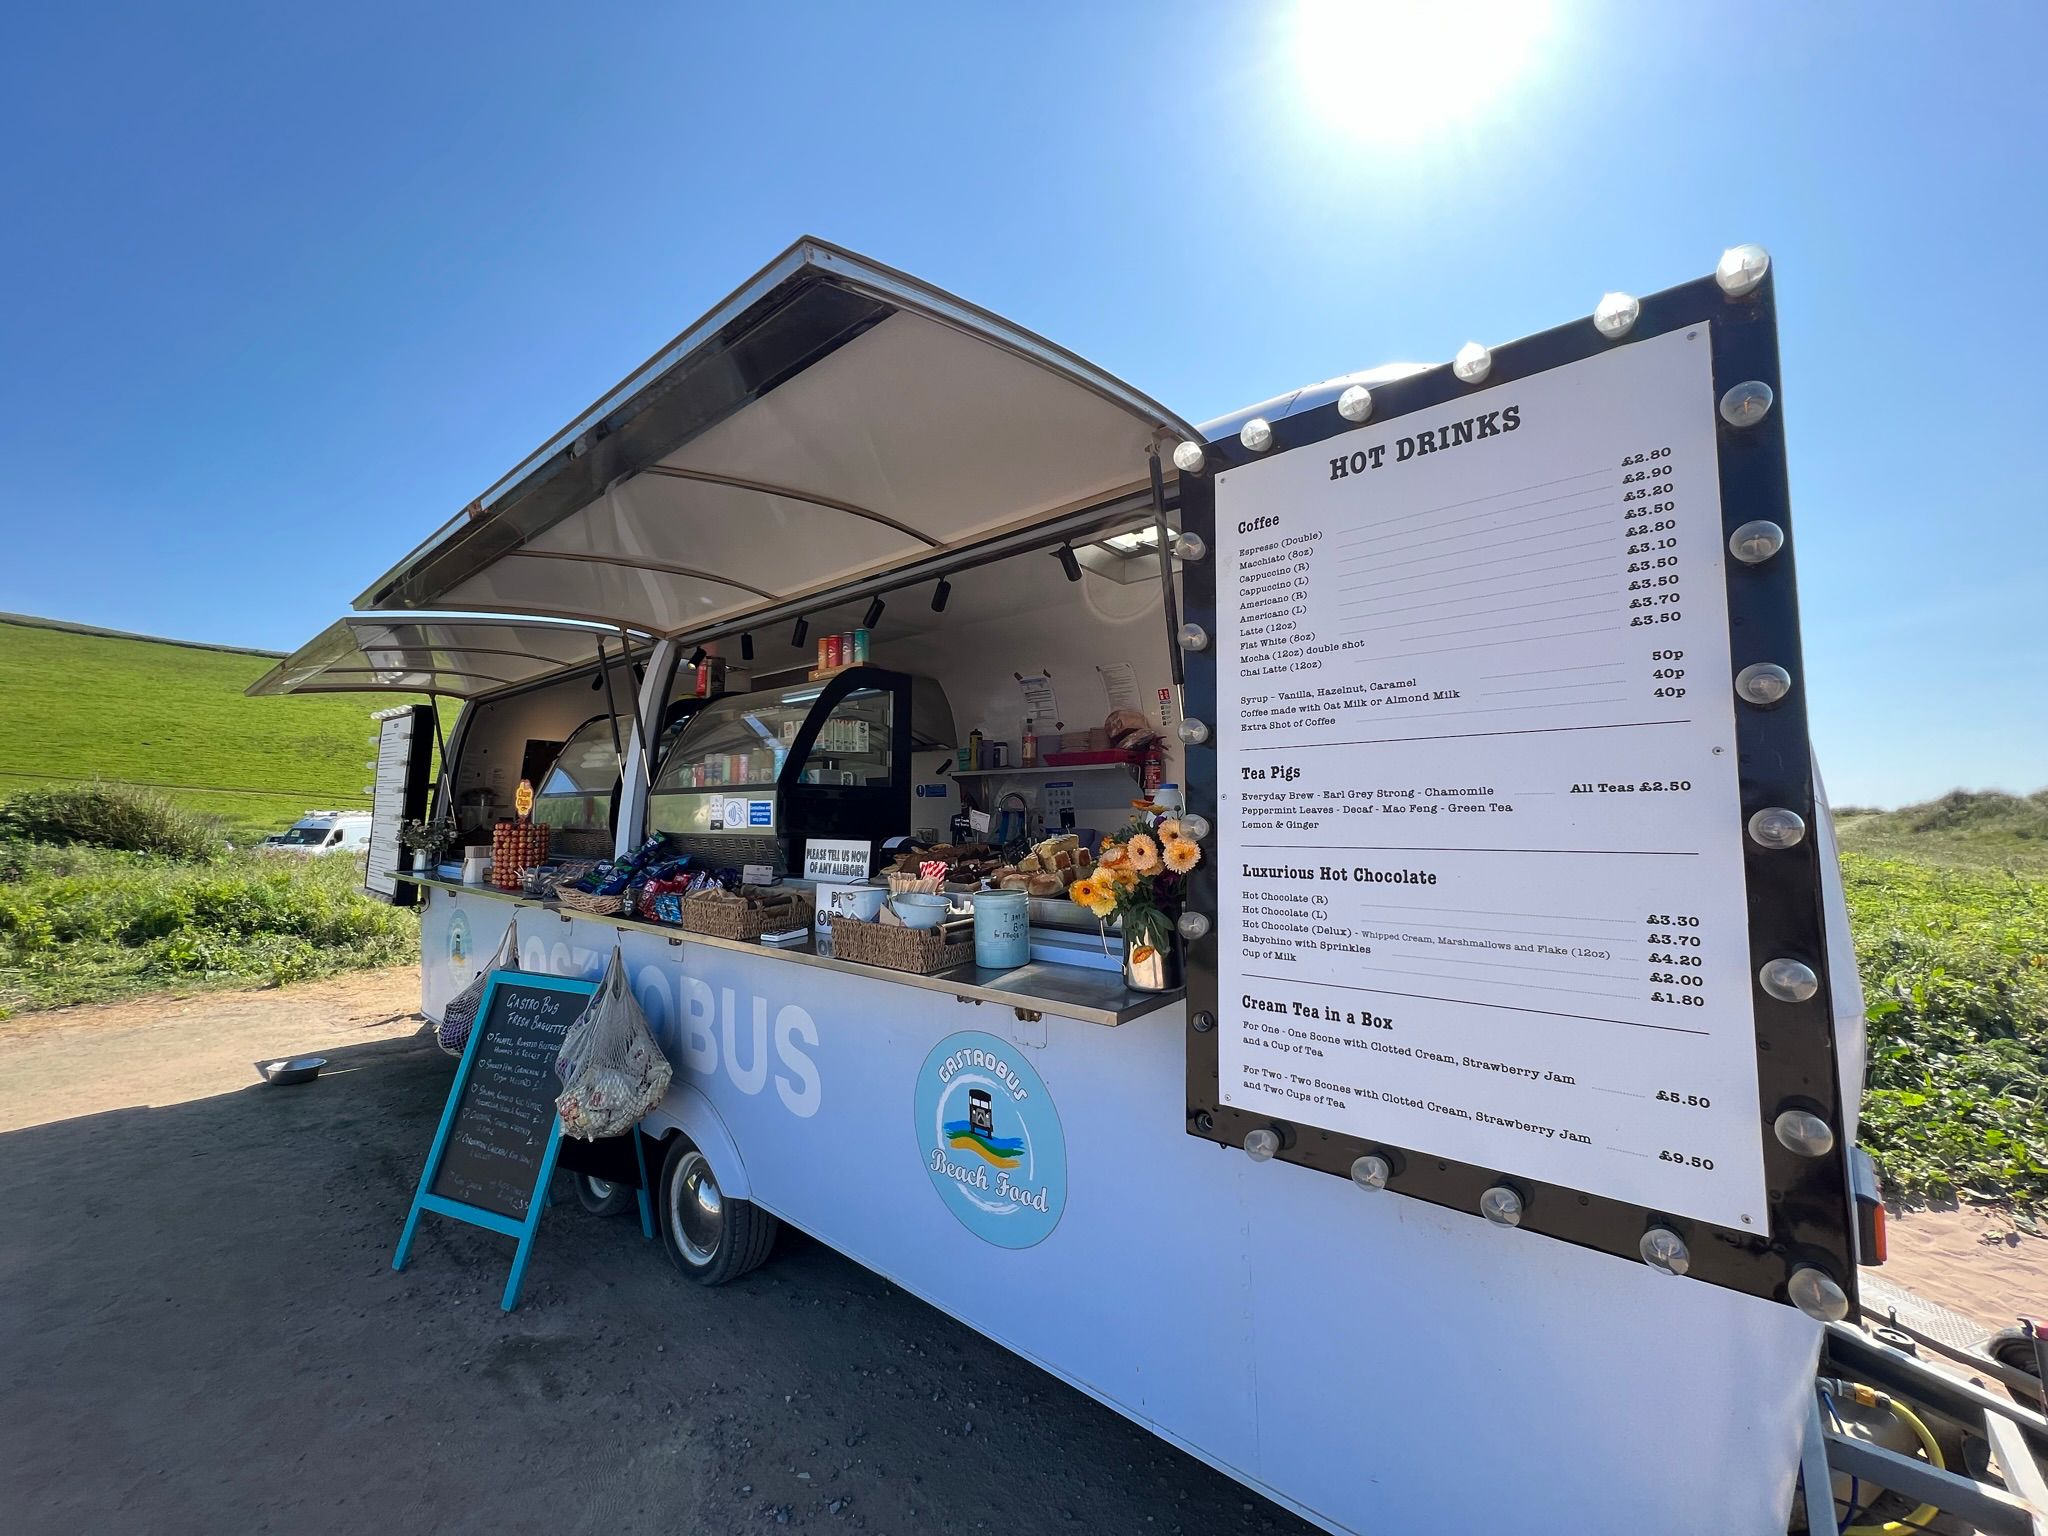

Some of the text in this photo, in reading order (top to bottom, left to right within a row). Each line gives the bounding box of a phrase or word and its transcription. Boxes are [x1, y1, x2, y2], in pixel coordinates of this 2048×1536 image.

[1329, 404, 1521, 481] HOT DRINKS
[1621, 447, 1672, 467] £2.80
[1622, 465, 1673, 485] £2.90
[1623, 483, 1674, 503] £3.20
[1624, 501, 1675, 520] £3.50
[1237, 515, 1280, 535] Coffee
[1625, 519, 1676, 538] £2.80
[1239, 530, 1323, 557] Espresso (Double)
[1626, 537, 1677, 556] £3.10
[1239, 546, 1314, 570] Macchiato (8oz)
[1626, 555, 1678, 574] £3.50
[1239, 561, 1310, 584] Cappuccino (R)
[1239, 576, 1310, 597] Cappuccino (L)
[1627, 574, 1679, 591] £3.50
[1239, 590, 1308, 610] Americano (R)
[1628, 592, 1681, 609] £3.70
[1239, 604, 1307, 624] Americano (L)
[1629, 611, 1682, 627] £3.50
[1239, 620, 1297, 637] Latte (12oz)
[1239, 631, 1316, 651] Flat White (8oz)
[1239, 639, 1365, 664] Mocha (12oz) double shot
[1652, 649, 1684, 661] 50p
[1240, 659, 1323, 678] Chai Latte (12oz)
[1652, 668, 1685, 680] 40p
[1240, 678, 1417, 706] Syrup Vanilla, Hazelnut, Caramel
[1653, 686, 1686, 699] 40p
[1240, 689, 1461, 719] Coffee made with Oat Milk or Almond Milk
[1240, 717, 1336, 732] Extra Shot of Coffee
[1241, 764, 1301, 782] Tea Pigs
[1241, 786, 1494, 802] Everyday Brew Earl Grey Strong Chamomile
[1569, 780, 1692, 794] All Teas £2.50
[1241, 802, 1514, 816] Peppermint Leaves Decaf Mao Feng Green Tea
[1241, 820, 1320, 831] Lemon & Ginger
[806, 848, 868, 863] PLEASE TELL US NOW
[809, 861, 865, 877] OF ANY ALLERGIES
[1242, 863, 1437, 885] Luxurious Hot Chocolate
[1242, 891, 1329, 906] Hot Chocolate (R)
[1241, 905, 1328, 921] Hot Chocolate (L)
[1646, 914, 1700, 927] £3.30
[1242, 919, 1611, 961] Hot Chocolate (Delux) Whipped Cream, Marshmallows and Flake (12oz)
[1242, 933, 1372, 954] Babychino with Sprinkles
[1647, 933, 1701, 947] £3.70
[1242, 948, 1297, 962] Cup of Milk
[1647, 952, 1702, 967] £4.20
[1649, 972, 1704, 987] £2.00
[1650, 991, 1705, 1007] £1.80
[1241, 994, 1394, 1031] Cream Tea in a Box
[1242, 1036, 1324, 1058] and a Cup of Tea
[1242, 1020, 1576, 1086] For One One Scone with Clotted Cream, Strawberry Jam
[937, 1047, 1029, 1102] GASTROBUS
[1243, 1080, 1346, 1110] and Two Cups of Tea
[1243, 1064, 1593, 1145] For Two Two Scones with Clotted Cream, Strawberry Jam
[1655, 1090, 1711, 1109] £5.50
[1658, 1150, 1714, 1171] £9.50
[930, 1148, 1050, 1214] Beach Food
